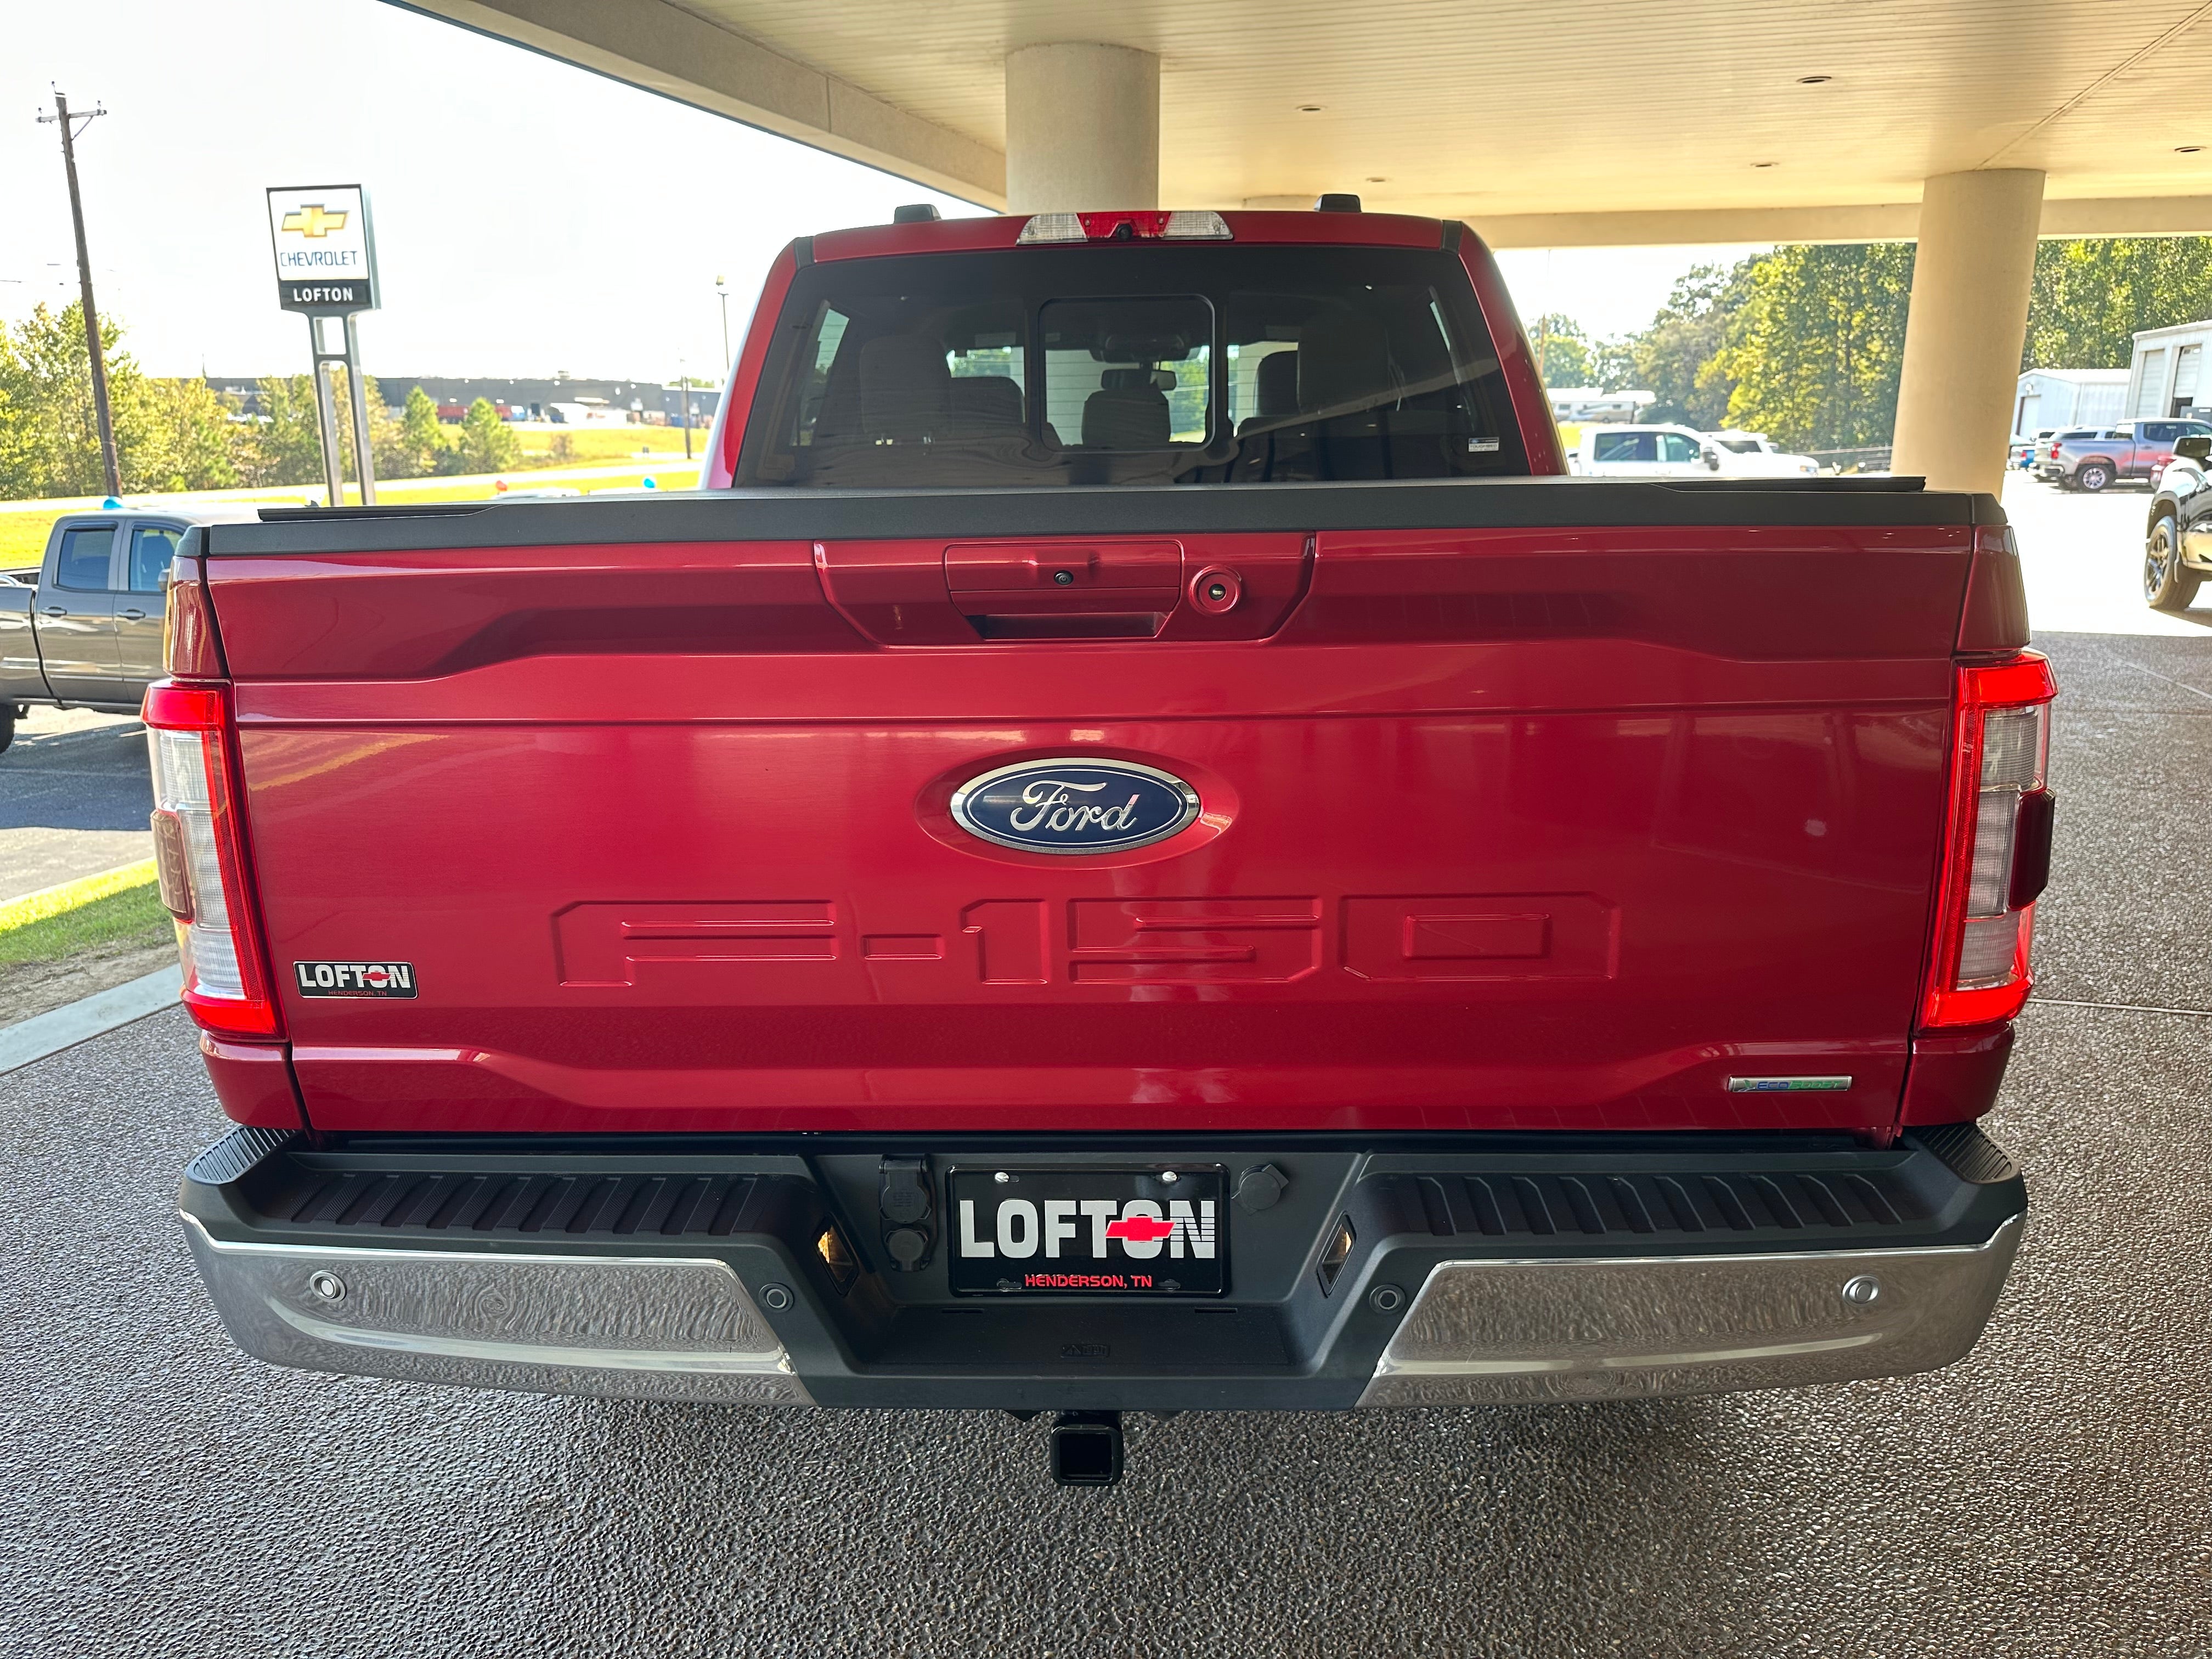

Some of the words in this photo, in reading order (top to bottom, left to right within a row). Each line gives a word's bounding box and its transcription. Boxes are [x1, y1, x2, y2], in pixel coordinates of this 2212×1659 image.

[280, 251, 357, 266] CHEVROLET
[293, 287, 353, 302] LOFTON
[1010, 780, 1141, 832] Ford
[551, 891, 1622, 988] F-150
[298, 964, 411, 988] LOFTON
[960, 1199, 1215, 1259] LOFTON
[1025, 1274, 1127, 1289] HENDERSON,
[1131, 1274, 1152, 1287] TN
